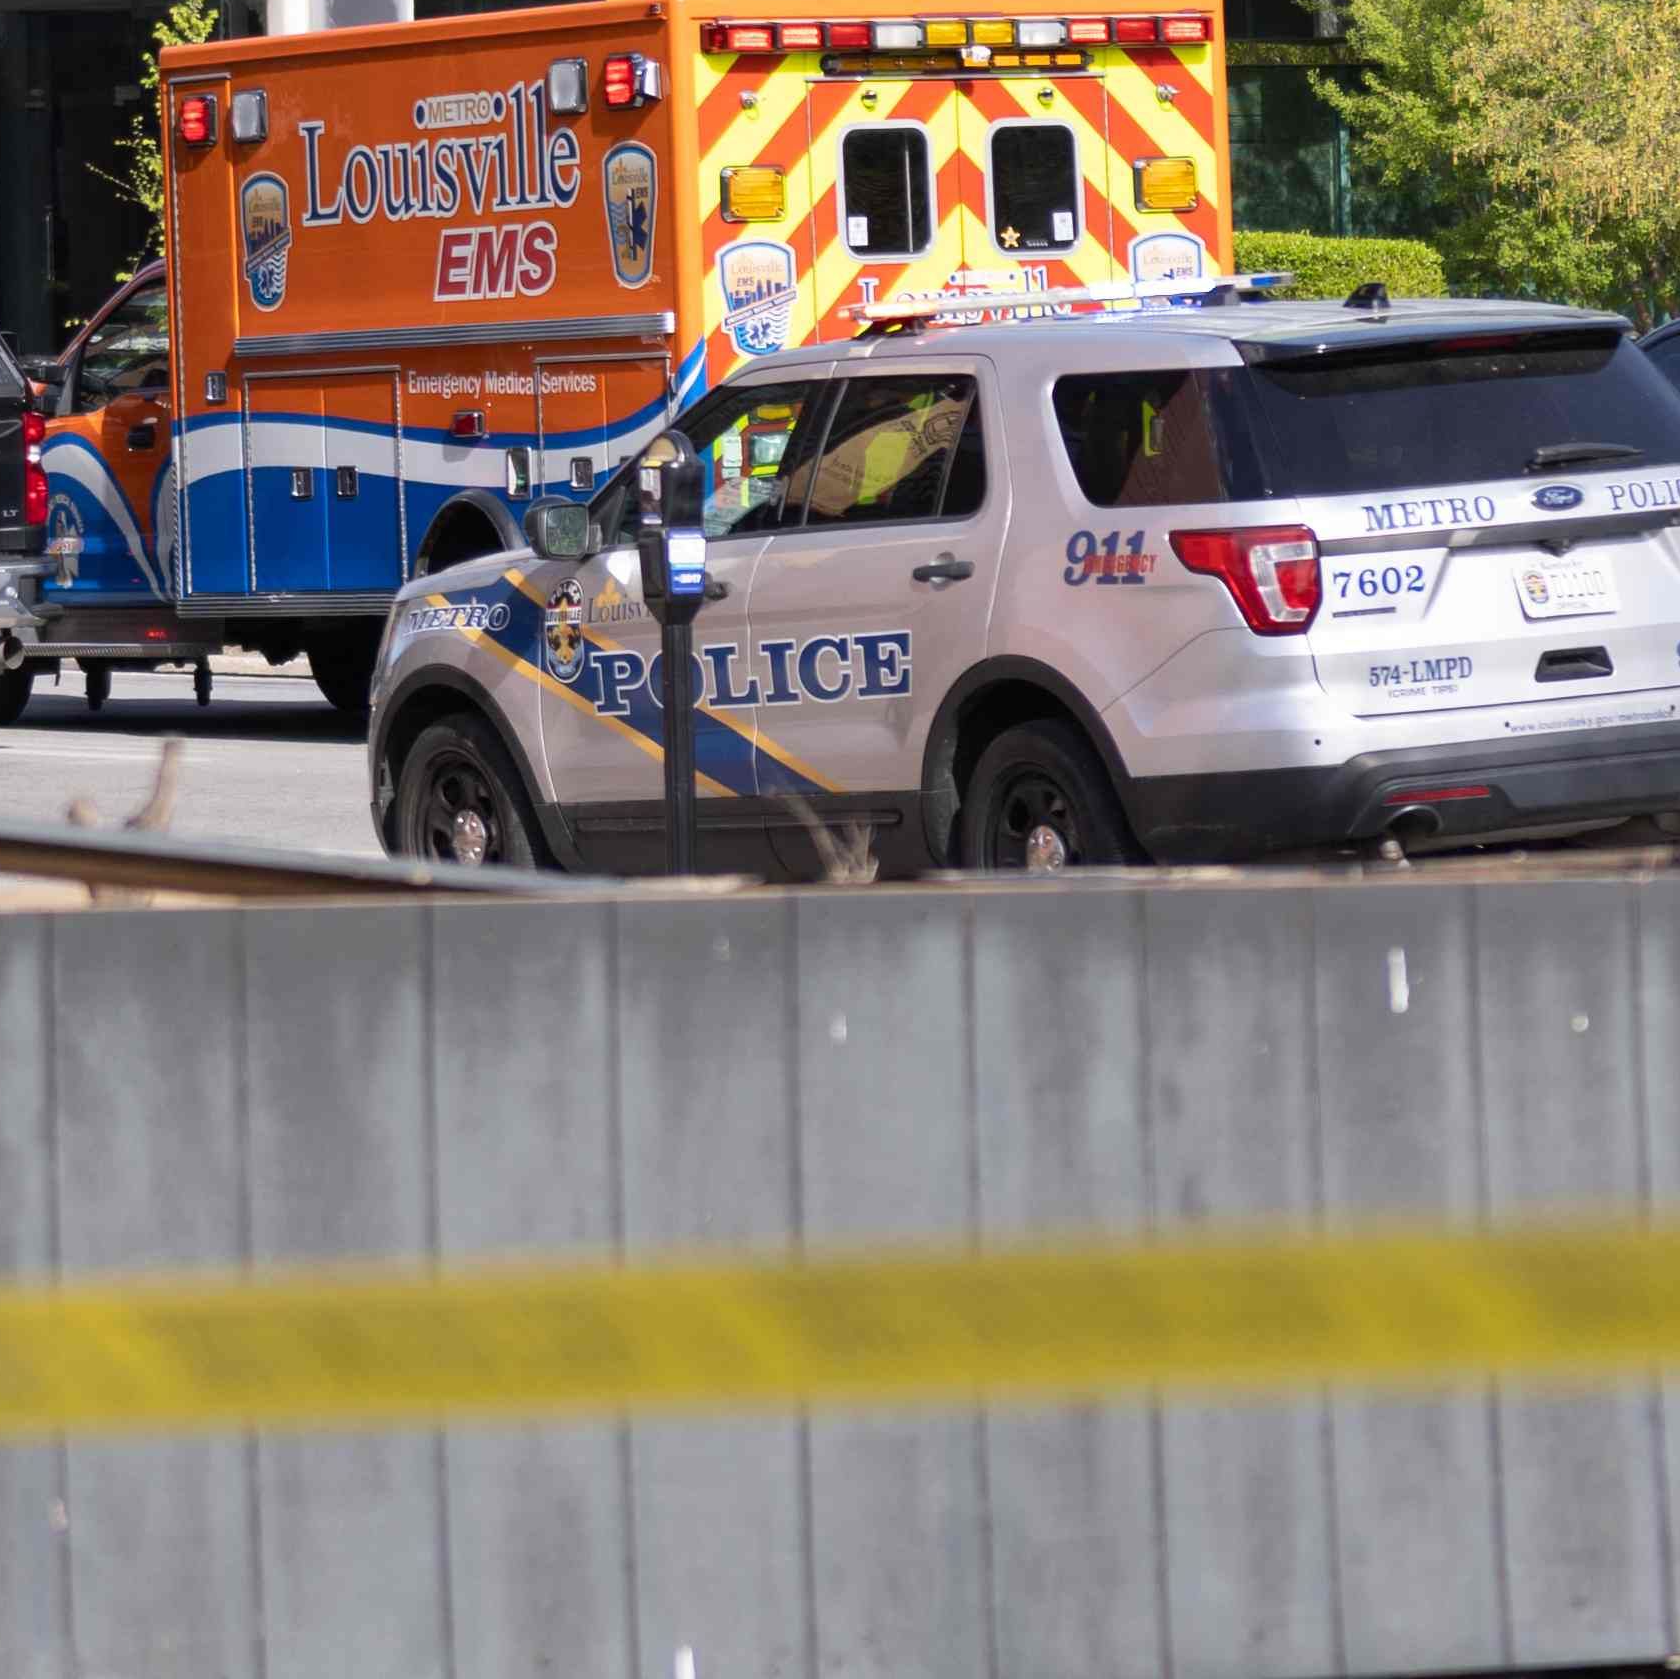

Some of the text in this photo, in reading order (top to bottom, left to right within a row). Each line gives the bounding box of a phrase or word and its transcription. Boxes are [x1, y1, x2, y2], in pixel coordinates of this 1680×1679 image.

[427, 96, 492, 123] METRO
[300, 79, 580, 225] Louisville
[434, 223, 558, 302] EMS
[407, 370, 598, 399] Emergency Medical Services
[1361, 494, 1497, 533] METRO
[1063, 529, 1146, 587] 911
[1332, 564, 1427, 599] 7602
[405, 601, 512, 635] METRO
[590, 629, 914, 716] POLICE
[1368, 656, 1474, 688] 574-LMPD
